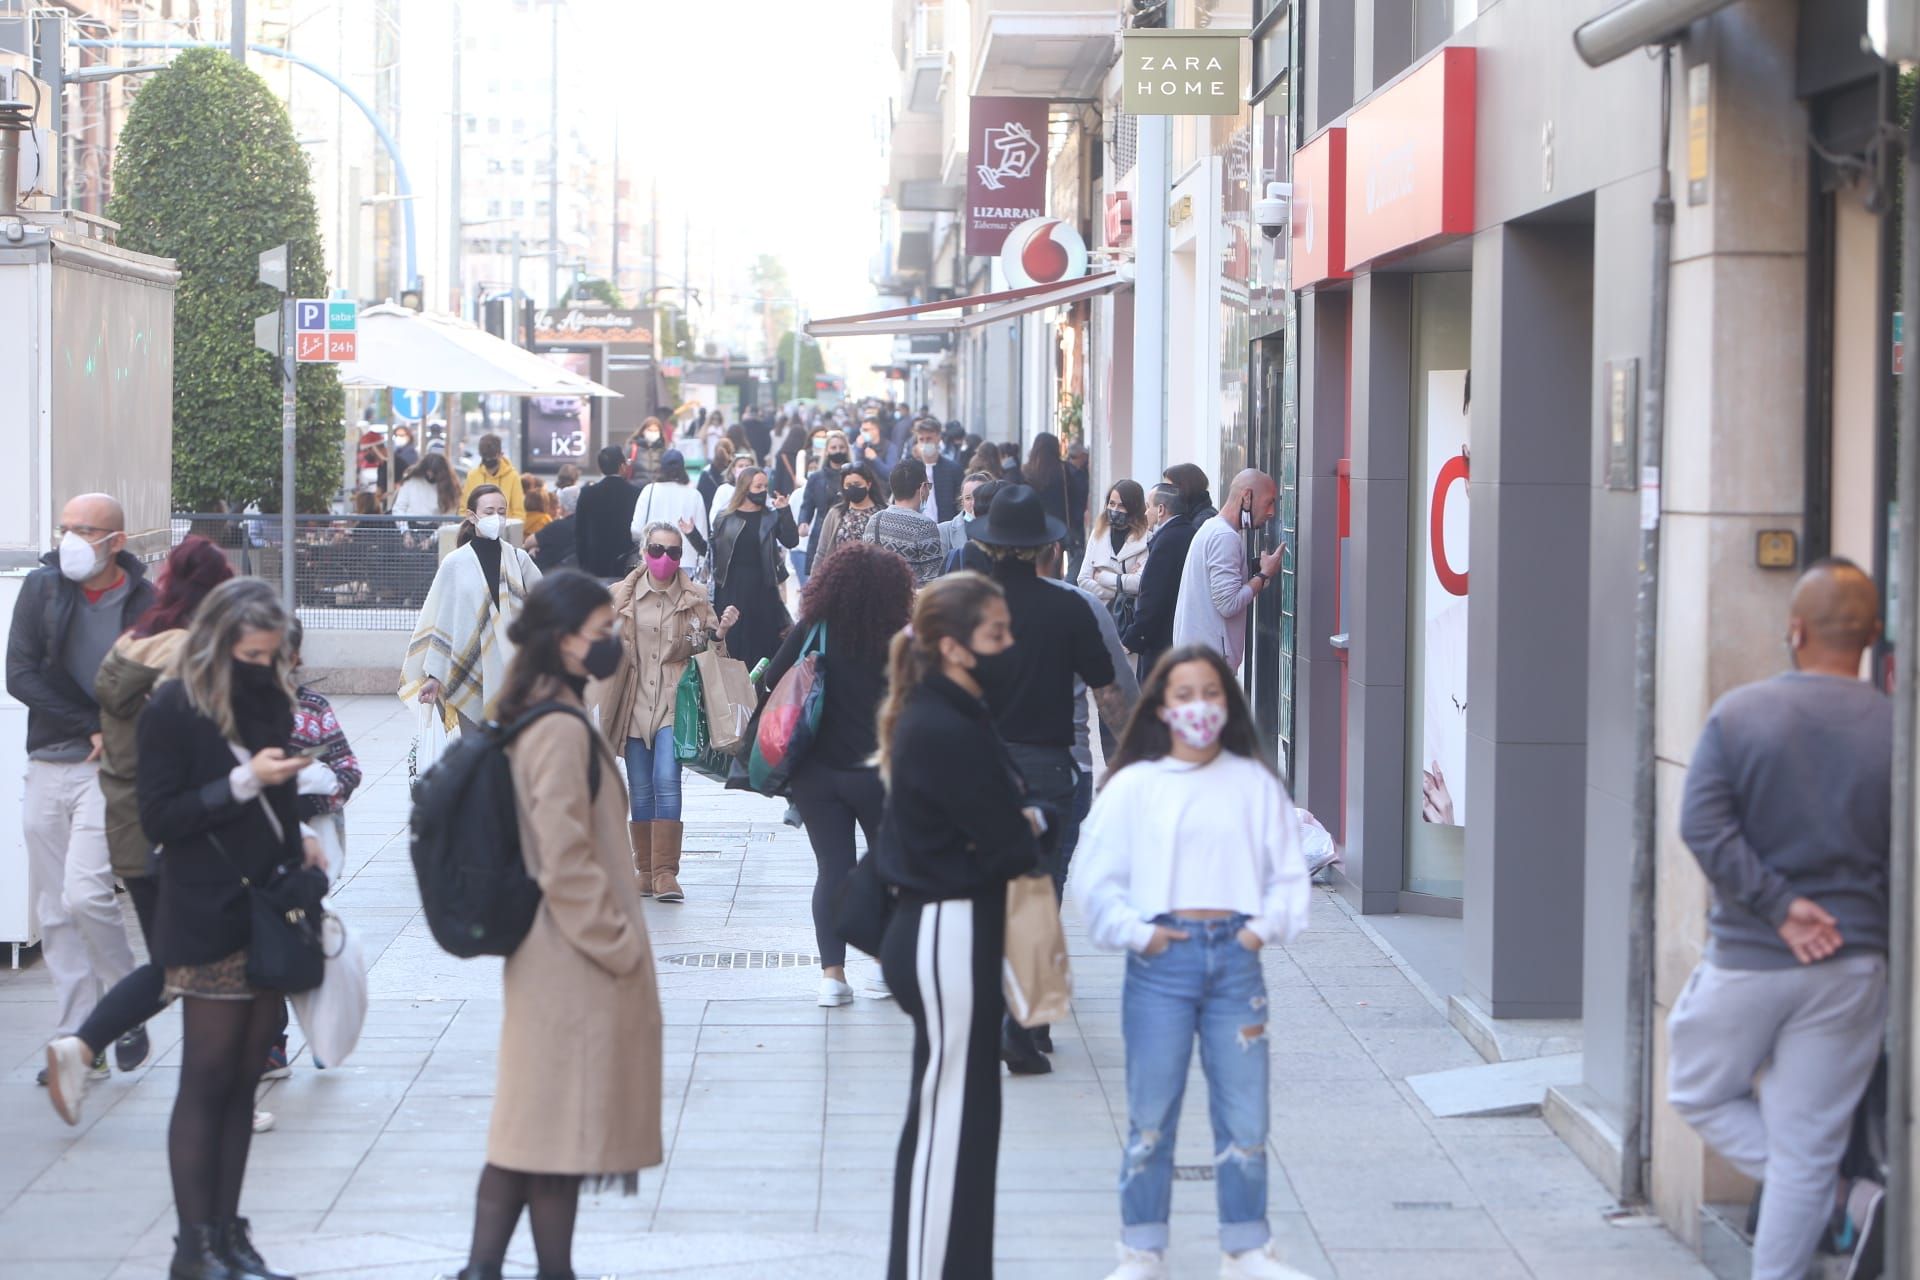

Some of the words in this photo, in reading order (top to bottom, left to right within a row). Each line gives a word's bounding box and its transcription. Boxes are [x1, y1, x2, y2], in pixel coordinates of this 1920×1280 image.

[1141, 57, 1222, 71] ZARA
[1138, 81, 1224, 95] HOME
[973, 207, 1040, 219] LIZARRAN
[304, 305, 319, 327] P
